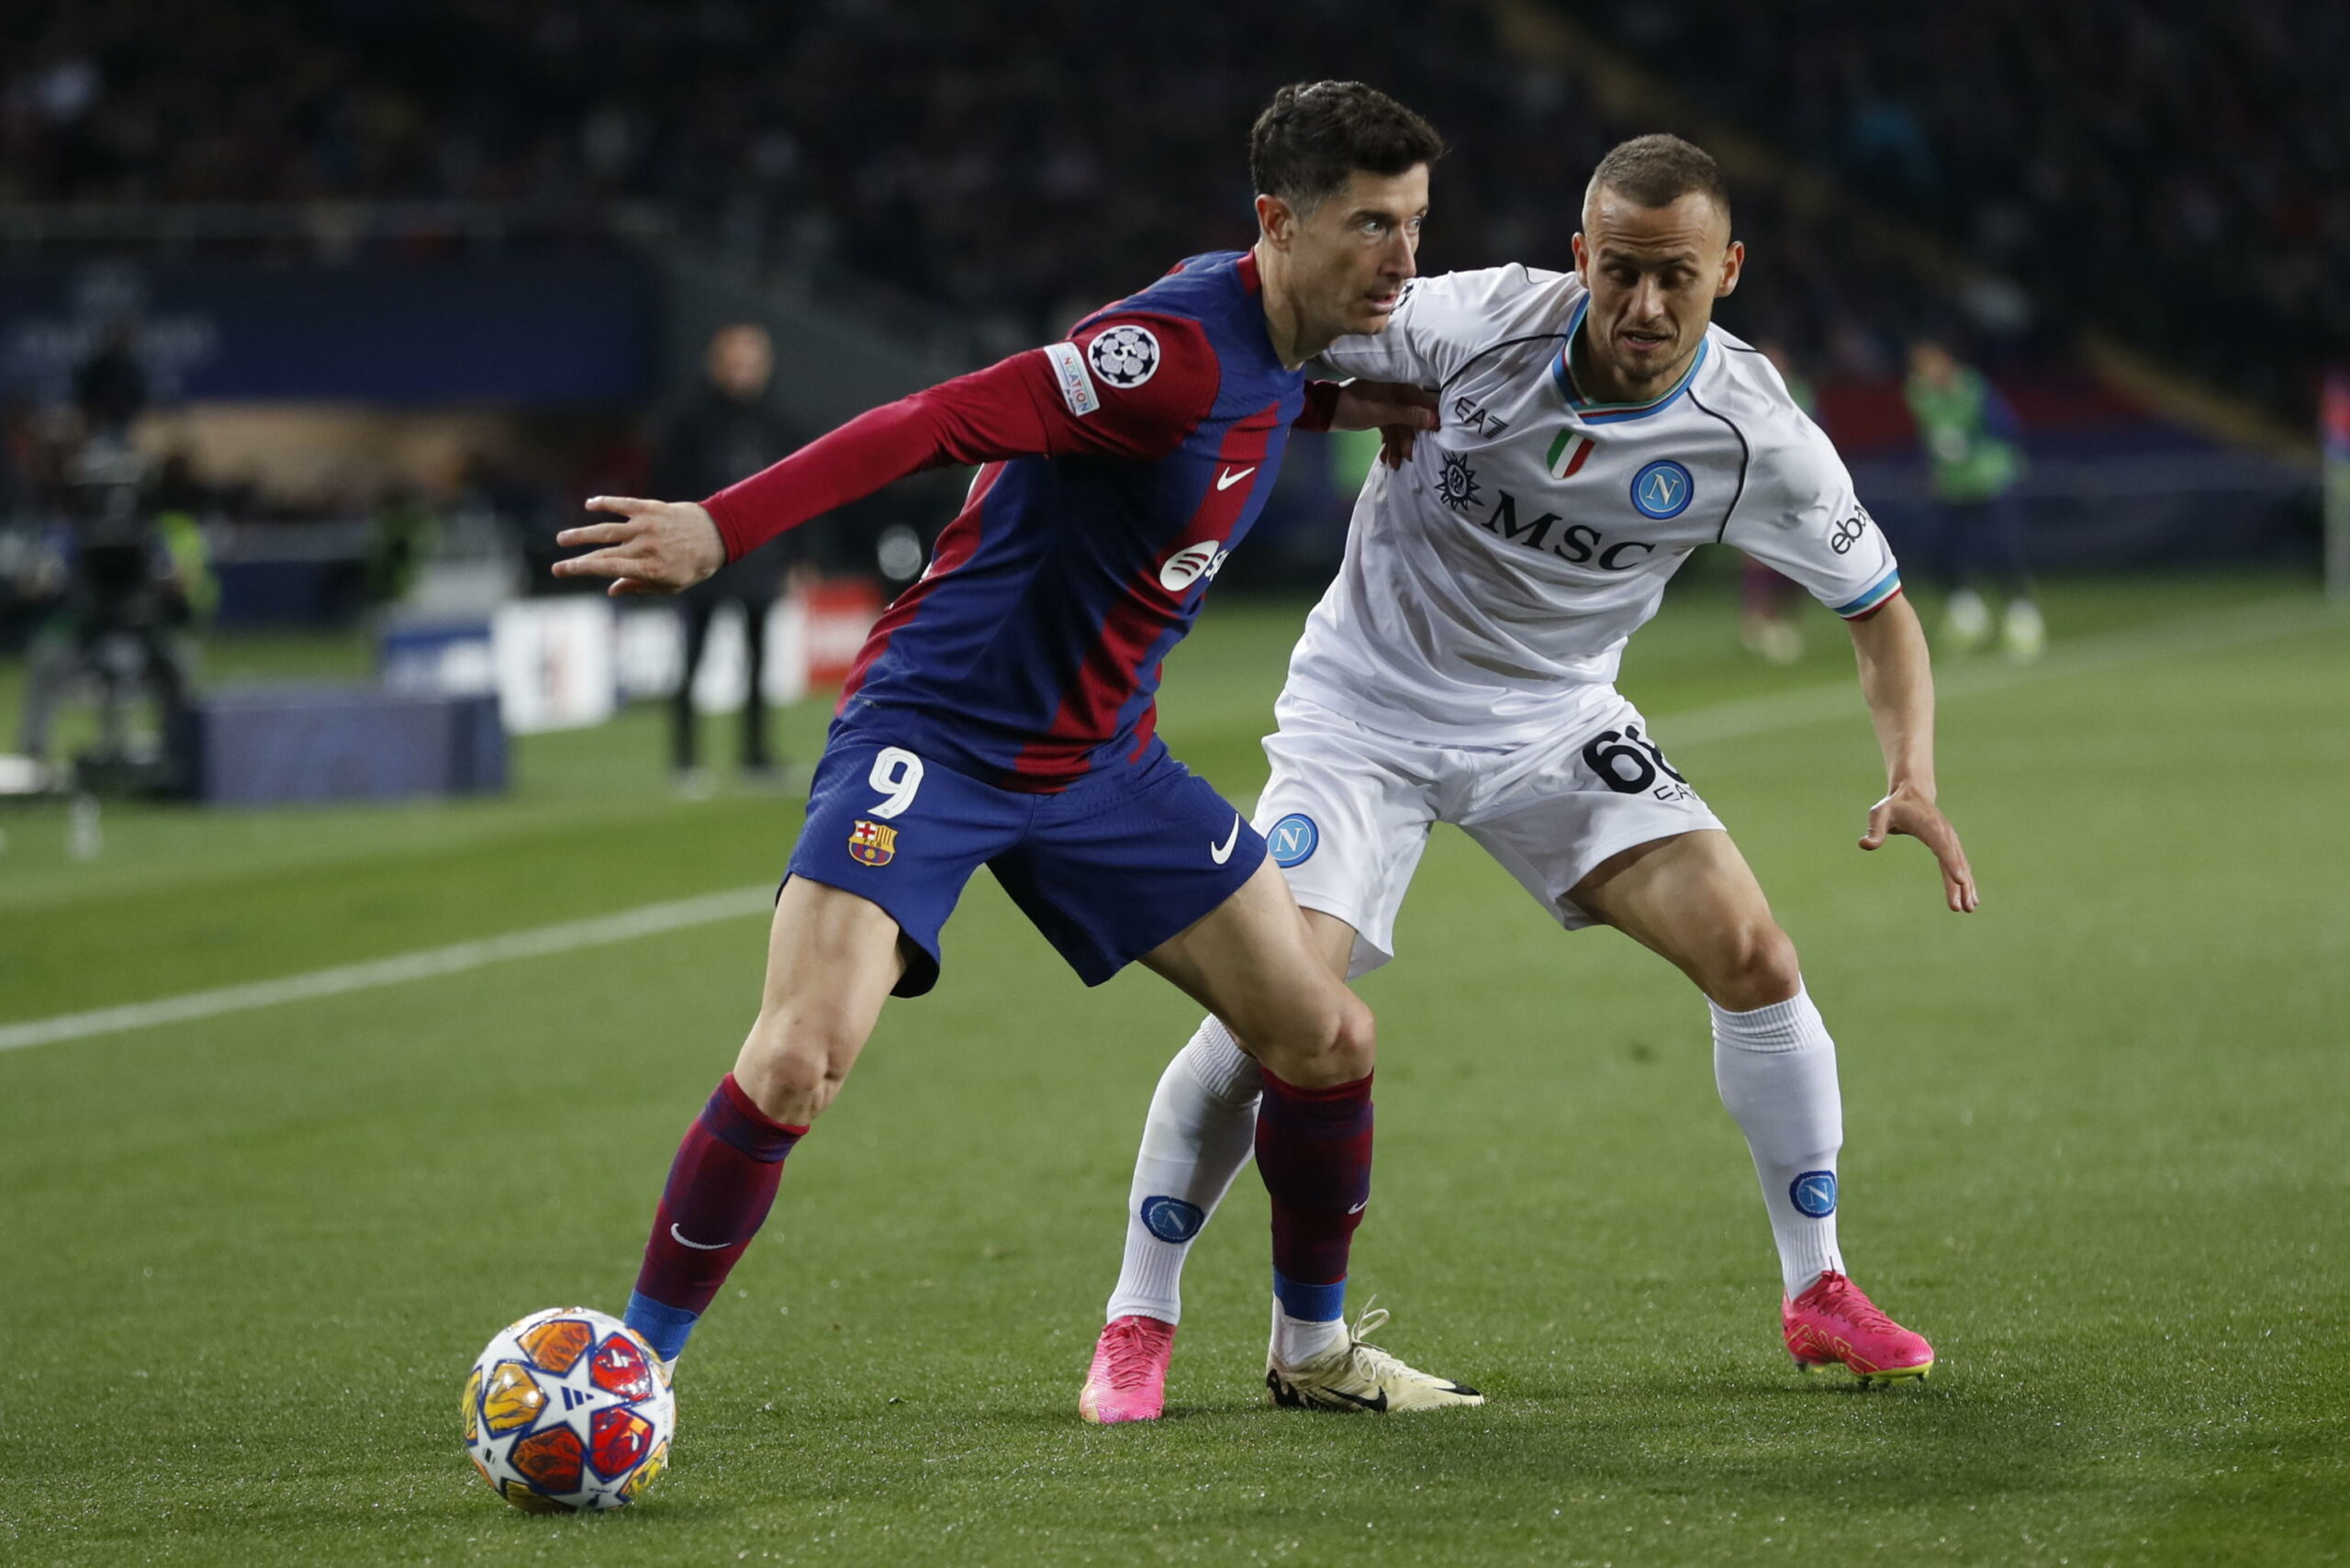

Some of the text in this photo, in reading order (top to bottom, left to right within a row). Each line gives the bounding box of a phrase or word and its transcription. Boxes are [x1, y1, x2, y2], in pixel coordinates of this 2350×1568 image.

[1111, 343, 1137, 362] 5
[1454, 396, 1510, 440] EA7
[1645, 473, 1680, 506] N
[1480, 488, 1657, 571] MSC
[1830, 504, 1872, 555] eba
[867, 745, 924, 820] 9
[1274, 827, 1304, 853] N
[1806, 1182, 1830, 1207] N
[1158, 1206, 1187, 1232] N
